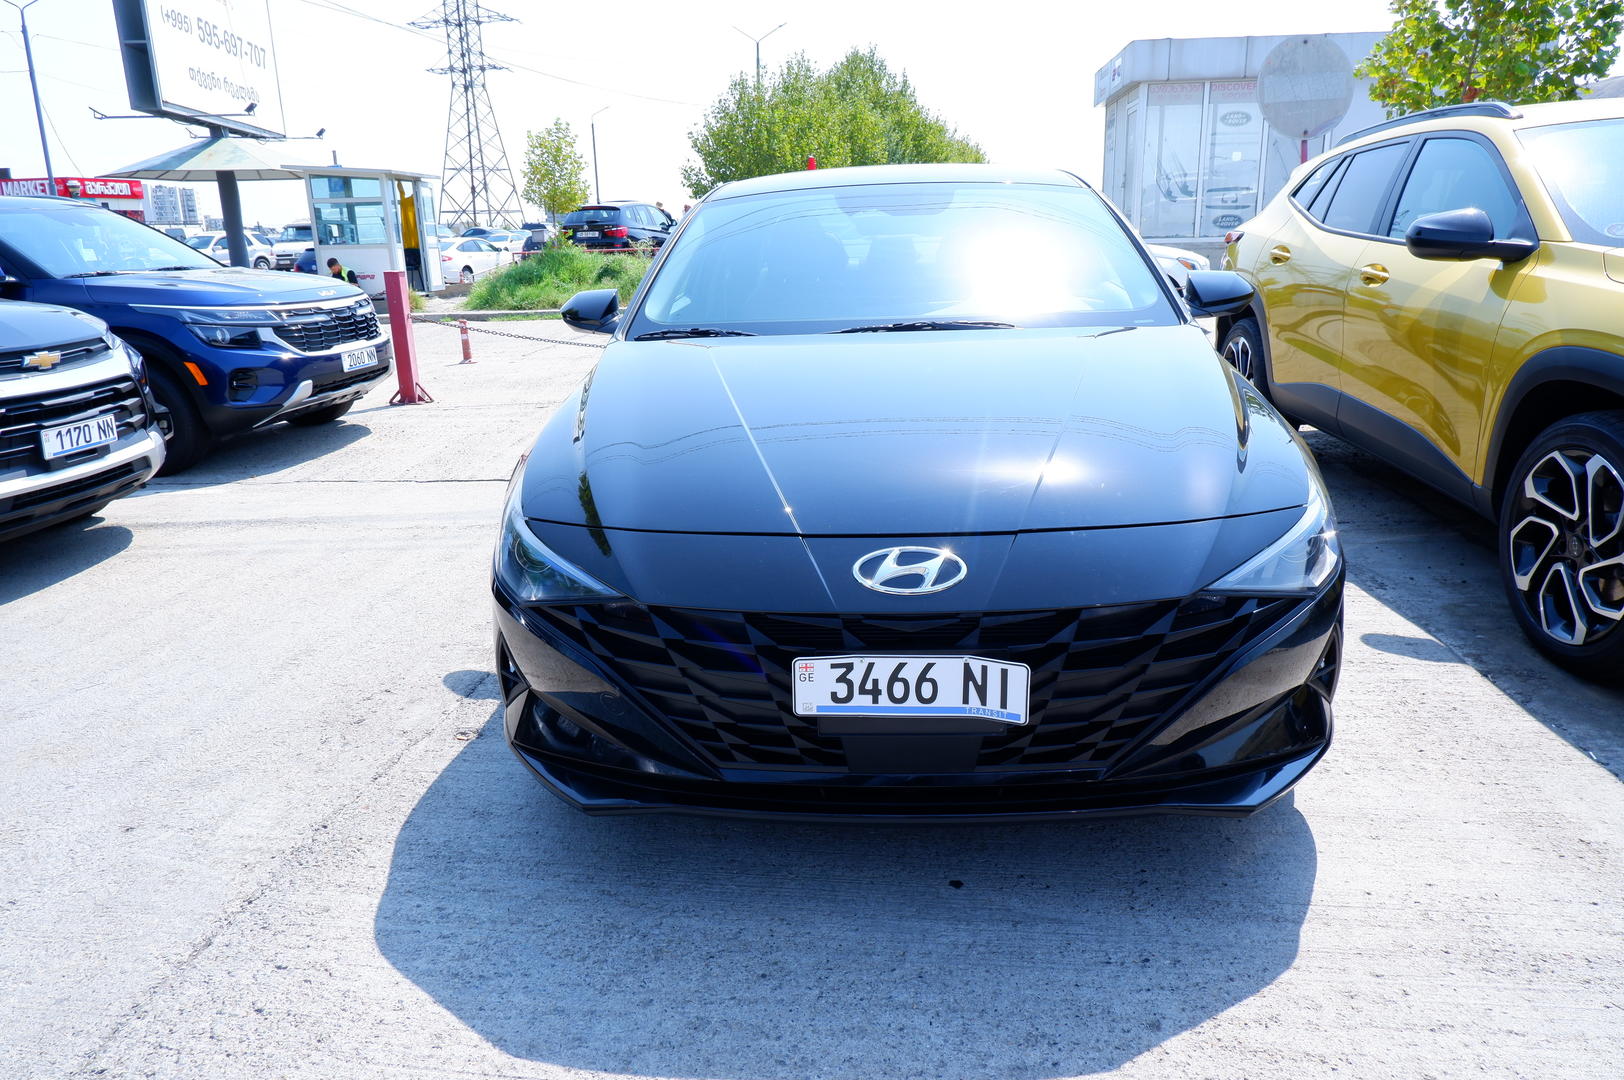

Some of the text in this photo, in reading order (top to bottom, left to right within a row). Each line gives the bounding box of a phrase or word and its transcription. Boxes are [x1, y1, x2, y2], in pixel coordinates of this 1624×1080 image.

[160, 4, 267, 70] (+995) 595-697-707
[188, 66, 222, 91] თქვენი
[2, 180, 50, 197] MARKET
[347, 348, 377, 367] 2060 NN
[56, 417, 115, 450] 1170 NN
[799, 672, 815, 683] GE
[829, 661, 1008, 710] 3466 NI
[965, 707, 1007, 719] TRANSIT
